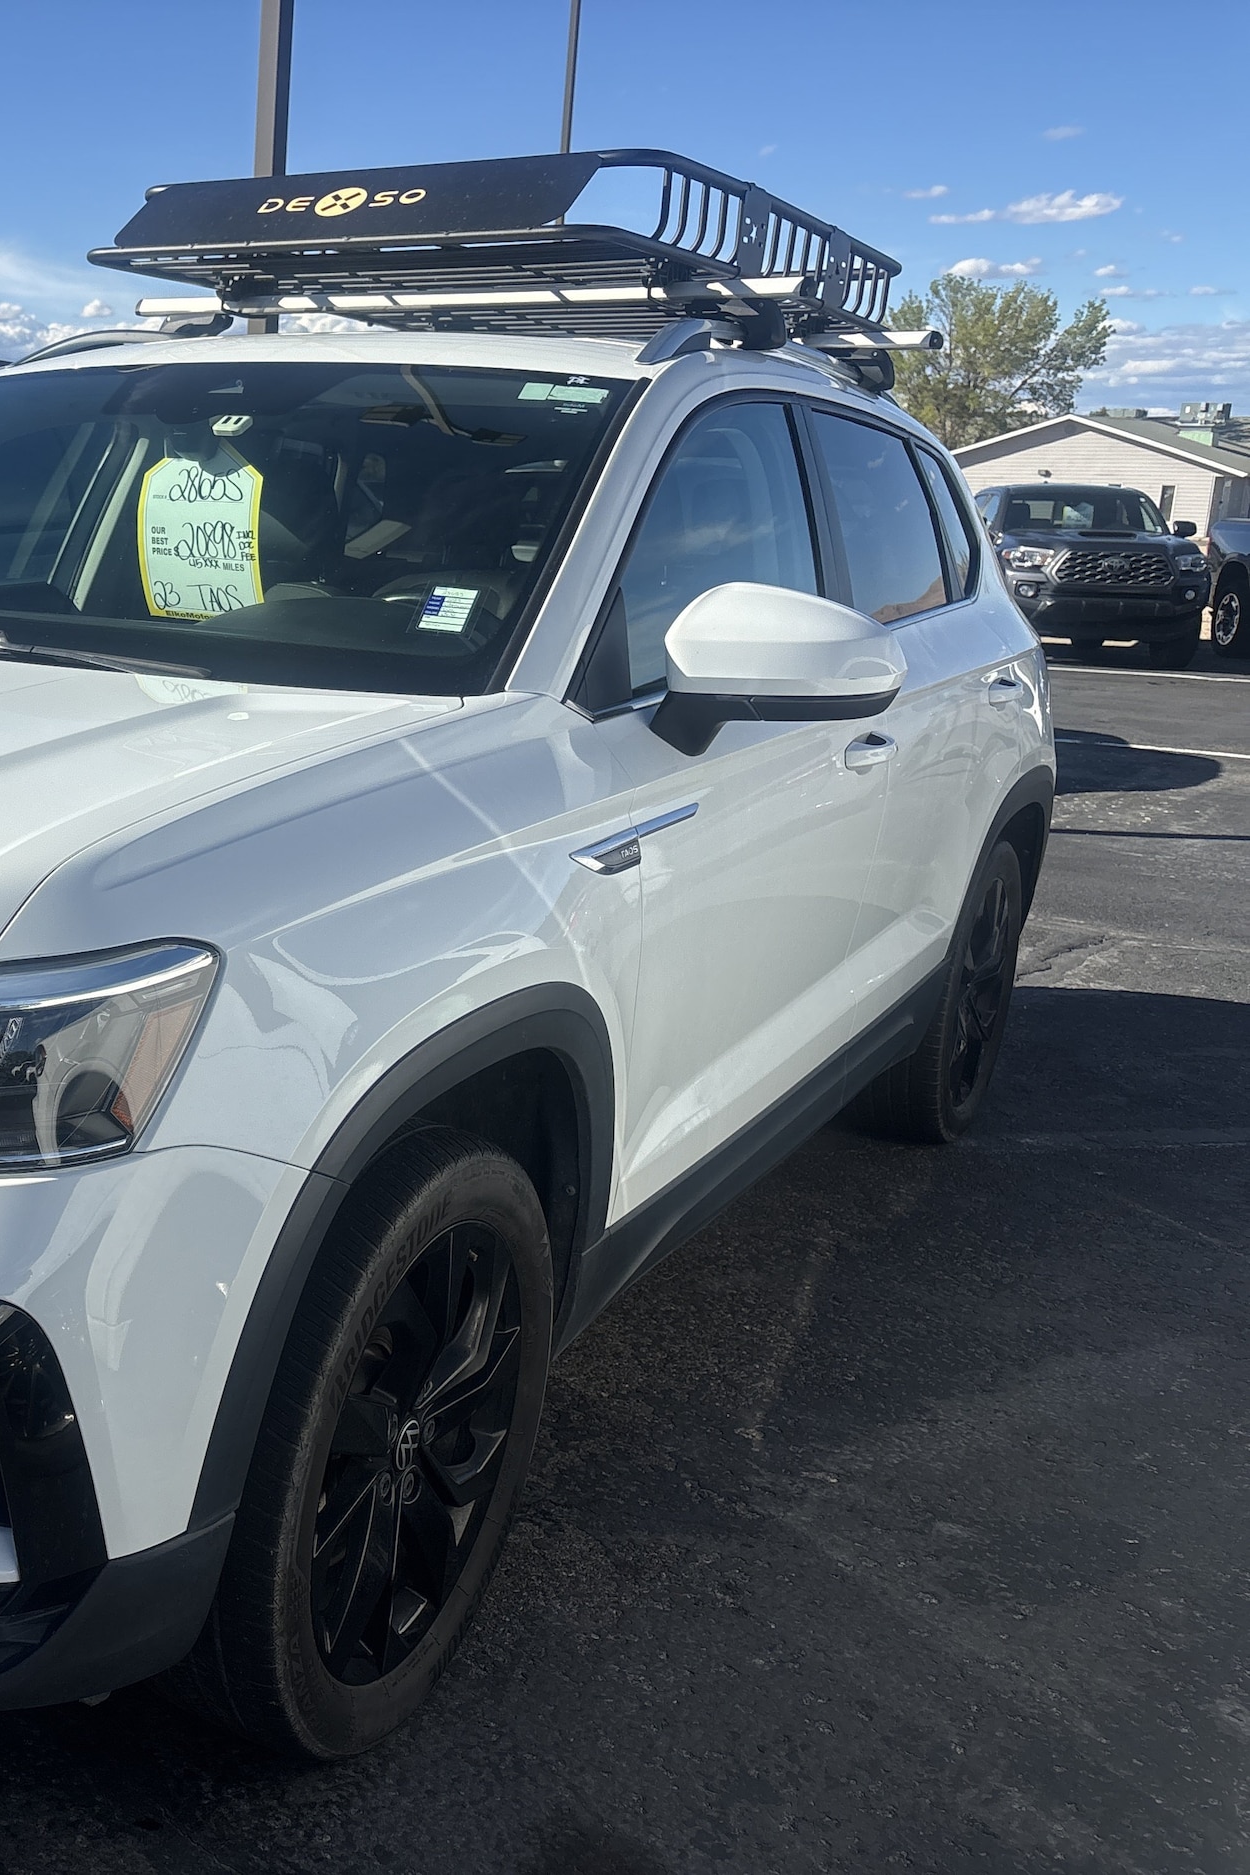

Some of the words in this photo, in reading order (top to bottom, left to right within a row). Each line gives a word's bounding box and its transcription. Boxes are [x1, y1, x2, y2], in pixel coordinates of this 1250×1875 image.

[151, 526, 166, 535] OUR
[151, 537, 168, 546] BEST
[152, 547, 172, 556] PRICE
[223, 562, 245, 572] MILES
[153, 581, 180, 610] 23
[186, 584, 244, 612] TAOS
[620, 844, 639, 859] TAOS
